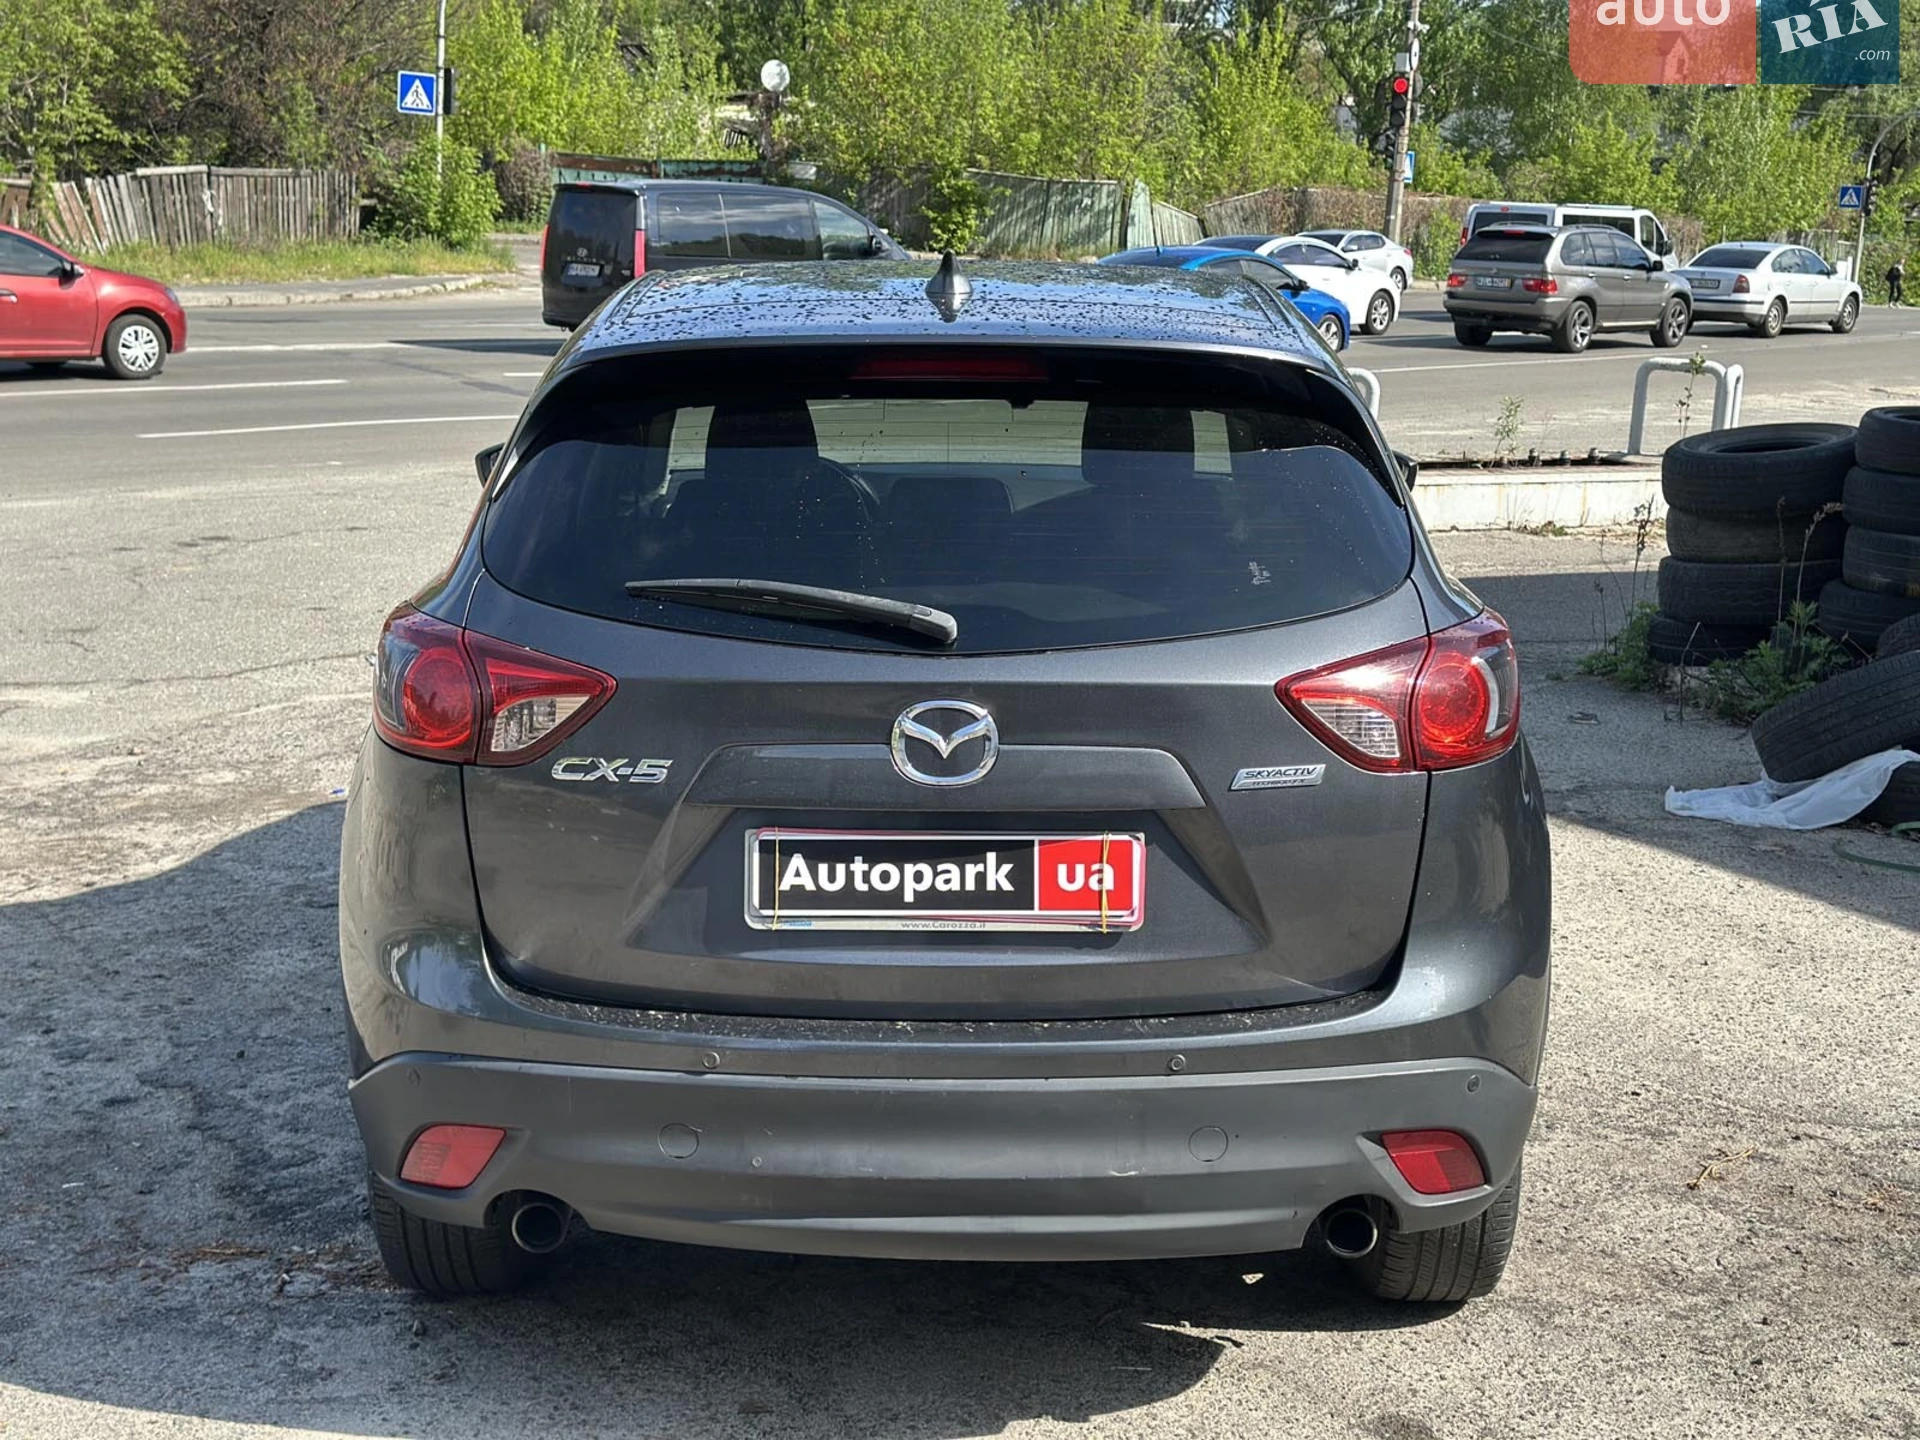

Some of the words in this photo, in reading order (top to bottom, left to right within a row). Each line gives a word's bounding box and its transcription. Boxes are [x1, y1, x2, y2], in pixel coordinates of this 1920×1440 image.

[551, 757, 673, 783] CX-5
[1244, 767, 1317, 779] SKYACTIV
[779, 852, 1015, 902] Autopark
[1057, 861, 1114, 891] ua
